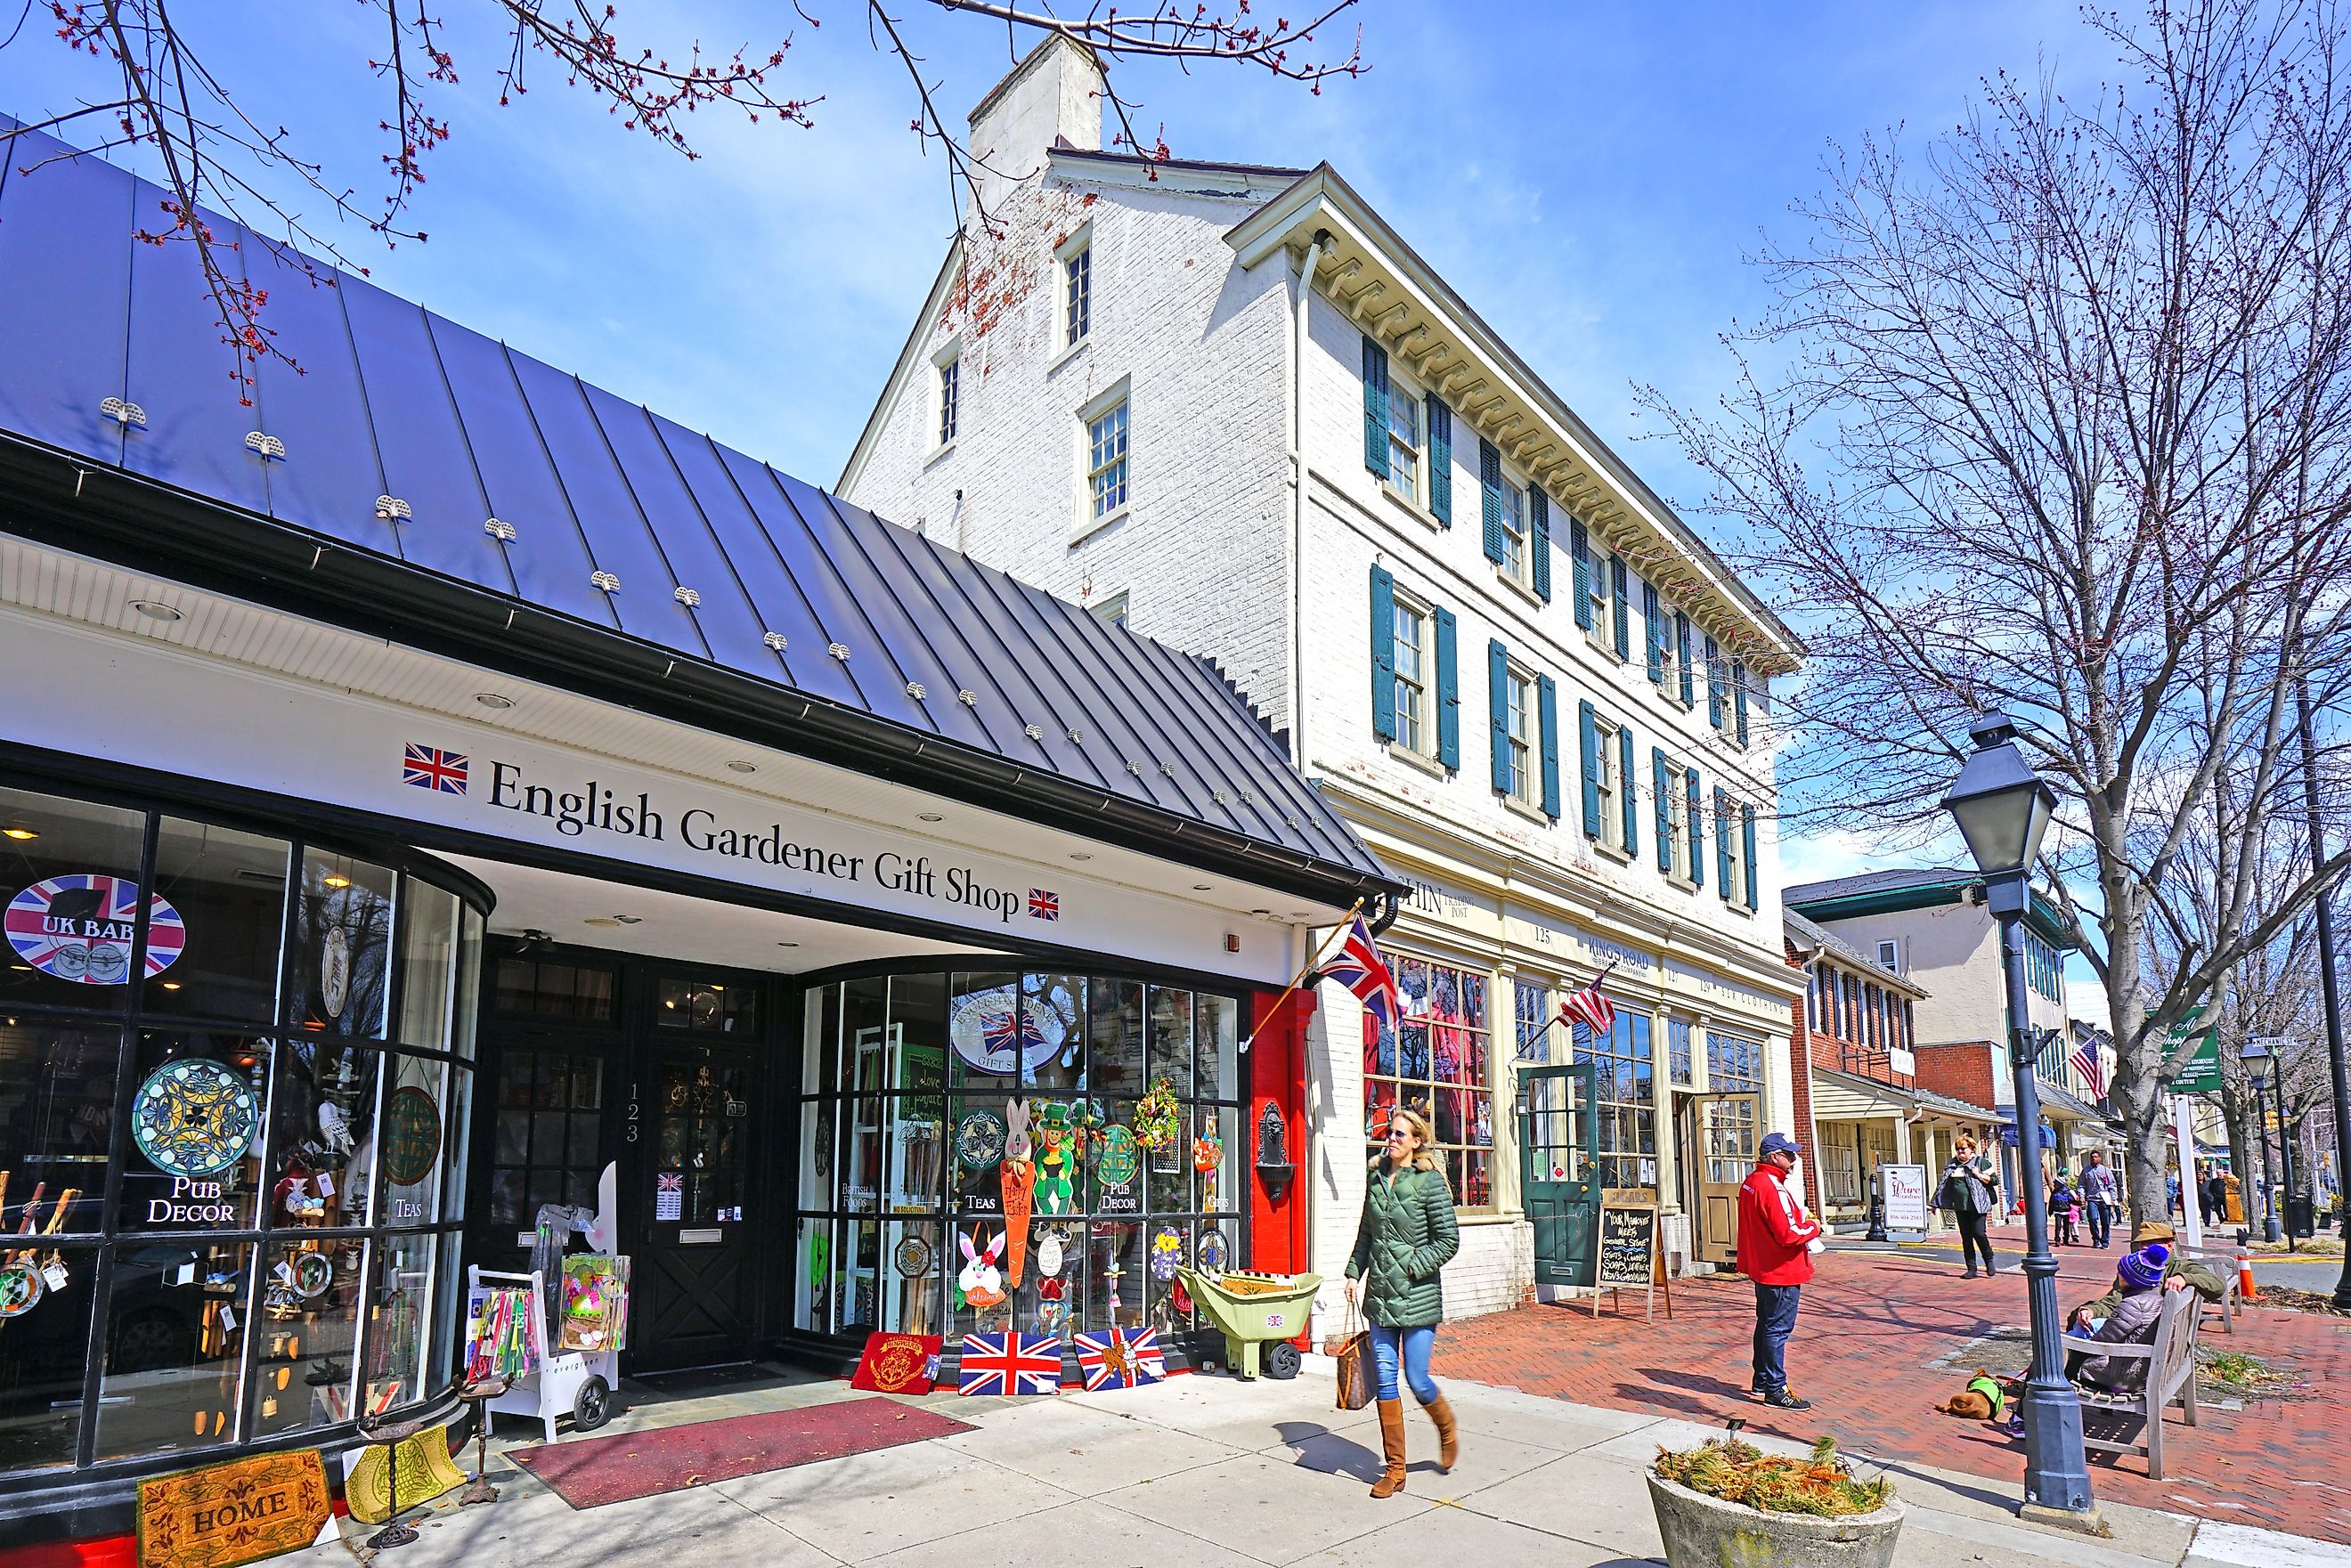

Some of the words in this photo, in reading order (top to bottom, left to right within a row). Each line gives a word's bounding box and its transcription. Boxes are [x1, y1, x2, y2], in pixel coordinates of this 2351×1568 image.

[487, 760, 665, 841] English
[680, 808, 864, 881] Gardener
[874, 852, 936, 898] Gift
[946, 868, 1020, 923] Shop
[1452, 907, 1468, 918] POST
[43, 915, 77, 935] UK
[83, 919, 152, 941] BAB
[1535, 927, 1550, 944] 125
[1623, 948, 1649, 970] ROAD
[1668, 969, 1679, 983] 127
[1701, 979, 1711, 993] 129
[2256, 1038, 2285, 1046] MECHANIC
[978, 1055, 1003, 1068] GIFT
[171, 1176, 221, 1198] PUB
[1110, 1182, 1129, 1195] PUB
[395, 1198, 422, 1217] TEAS
[965, 1195, 996, 1209] TEAS
[1102, 1196, 1136, 1209] DECOR
[147, 1199, 235, 1223] DECOR
[1617, 1226, 1638, 1238] MEETS
[1603, 1235, 1628, 1246] GENERAL
[2129, 1255, 2152, 1277] STATE
[886, 1339, 921, 1351] HOGWARTS
[554, 1358, 598, 1374] evergreen
[192, 1491, 289, 1535] HOME
